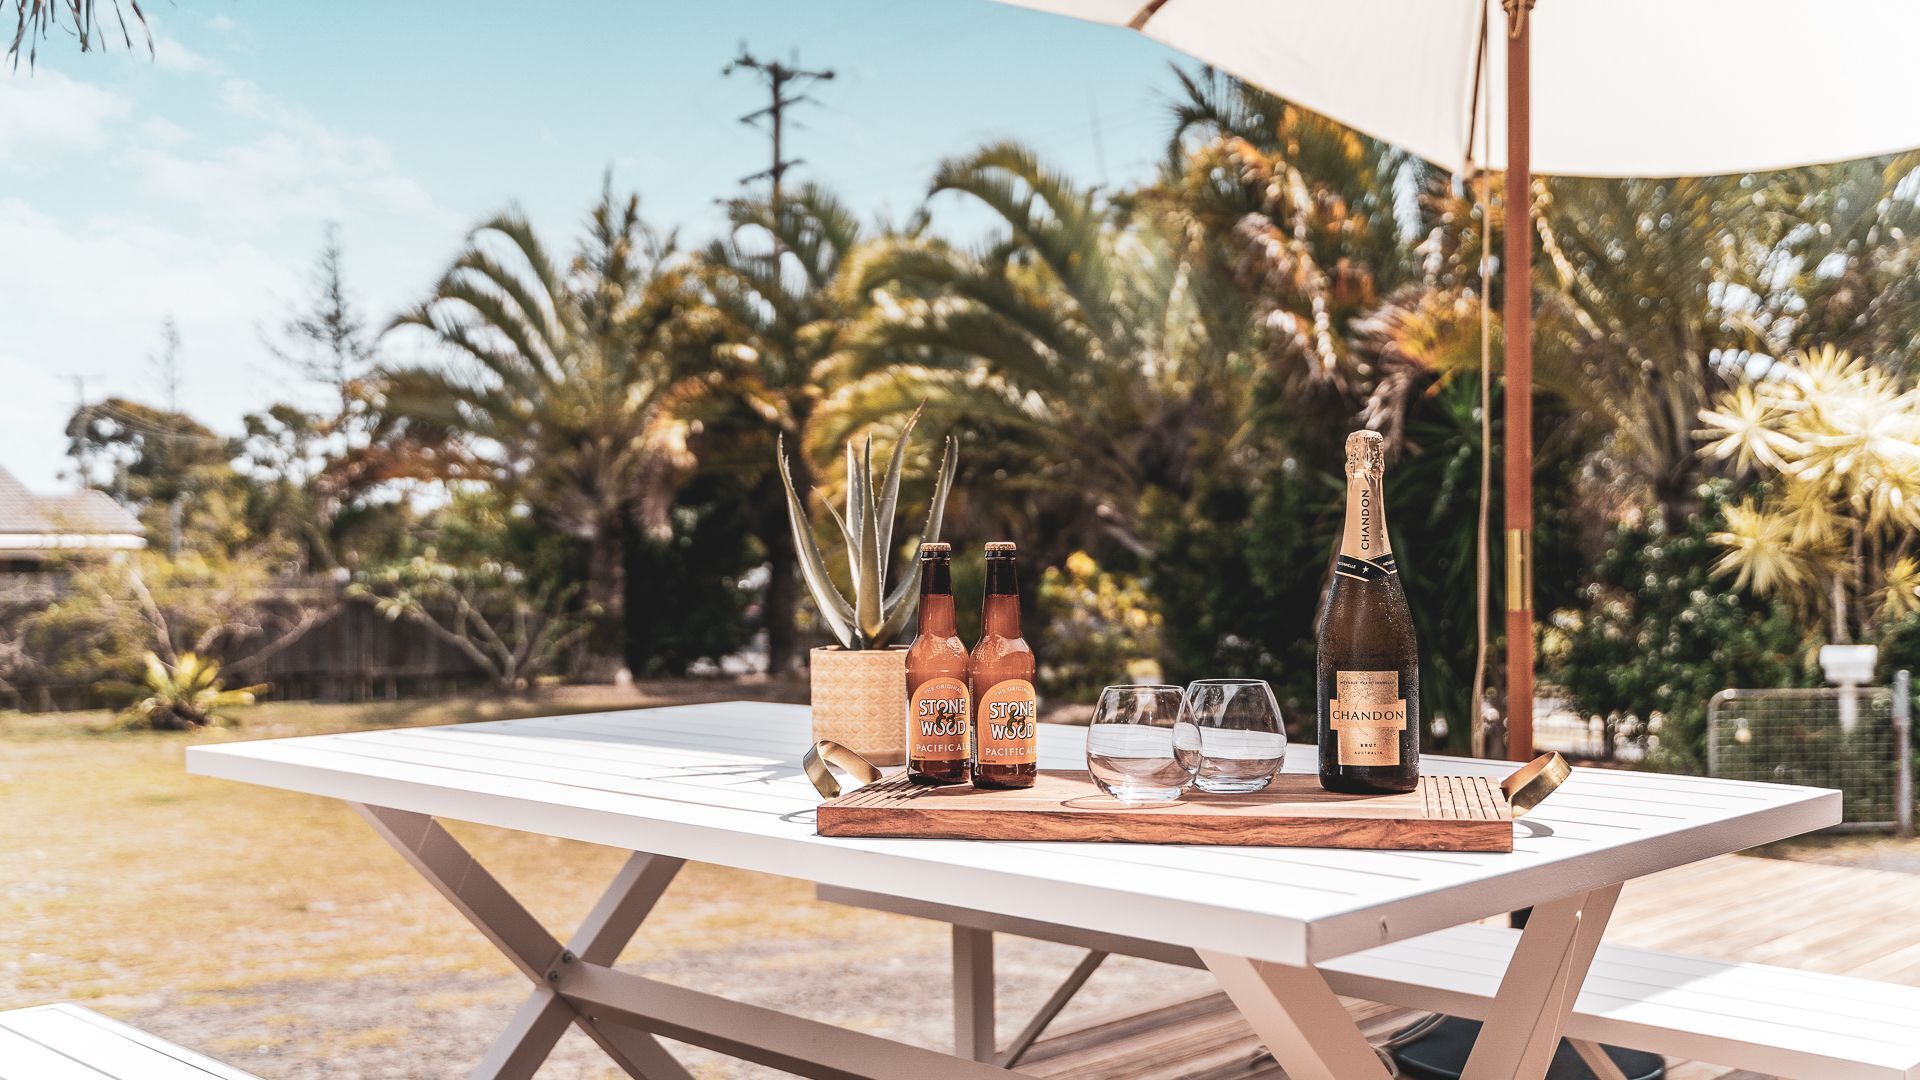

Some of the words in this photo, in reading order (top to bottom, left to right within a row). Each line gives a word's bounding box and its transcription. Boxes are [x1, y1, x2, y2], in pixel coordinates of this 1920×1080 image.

[1361, 489, 1370, 550] CHANDON
[924, 687, 935, 695] THE
[994, 689, 1006, 698] THE
[919, 699, 966, 717] STONE
[989, 701, 1034, 719] STONE
[1332, 710, 1404, 721] CHANDON
[920, 719, 967, 736] WOOD
[990, 722, 1034, 740] WOOD
[916, 743, 955, 752] PACIFIC
[985, 747, 1025, 756] PACIFIC
